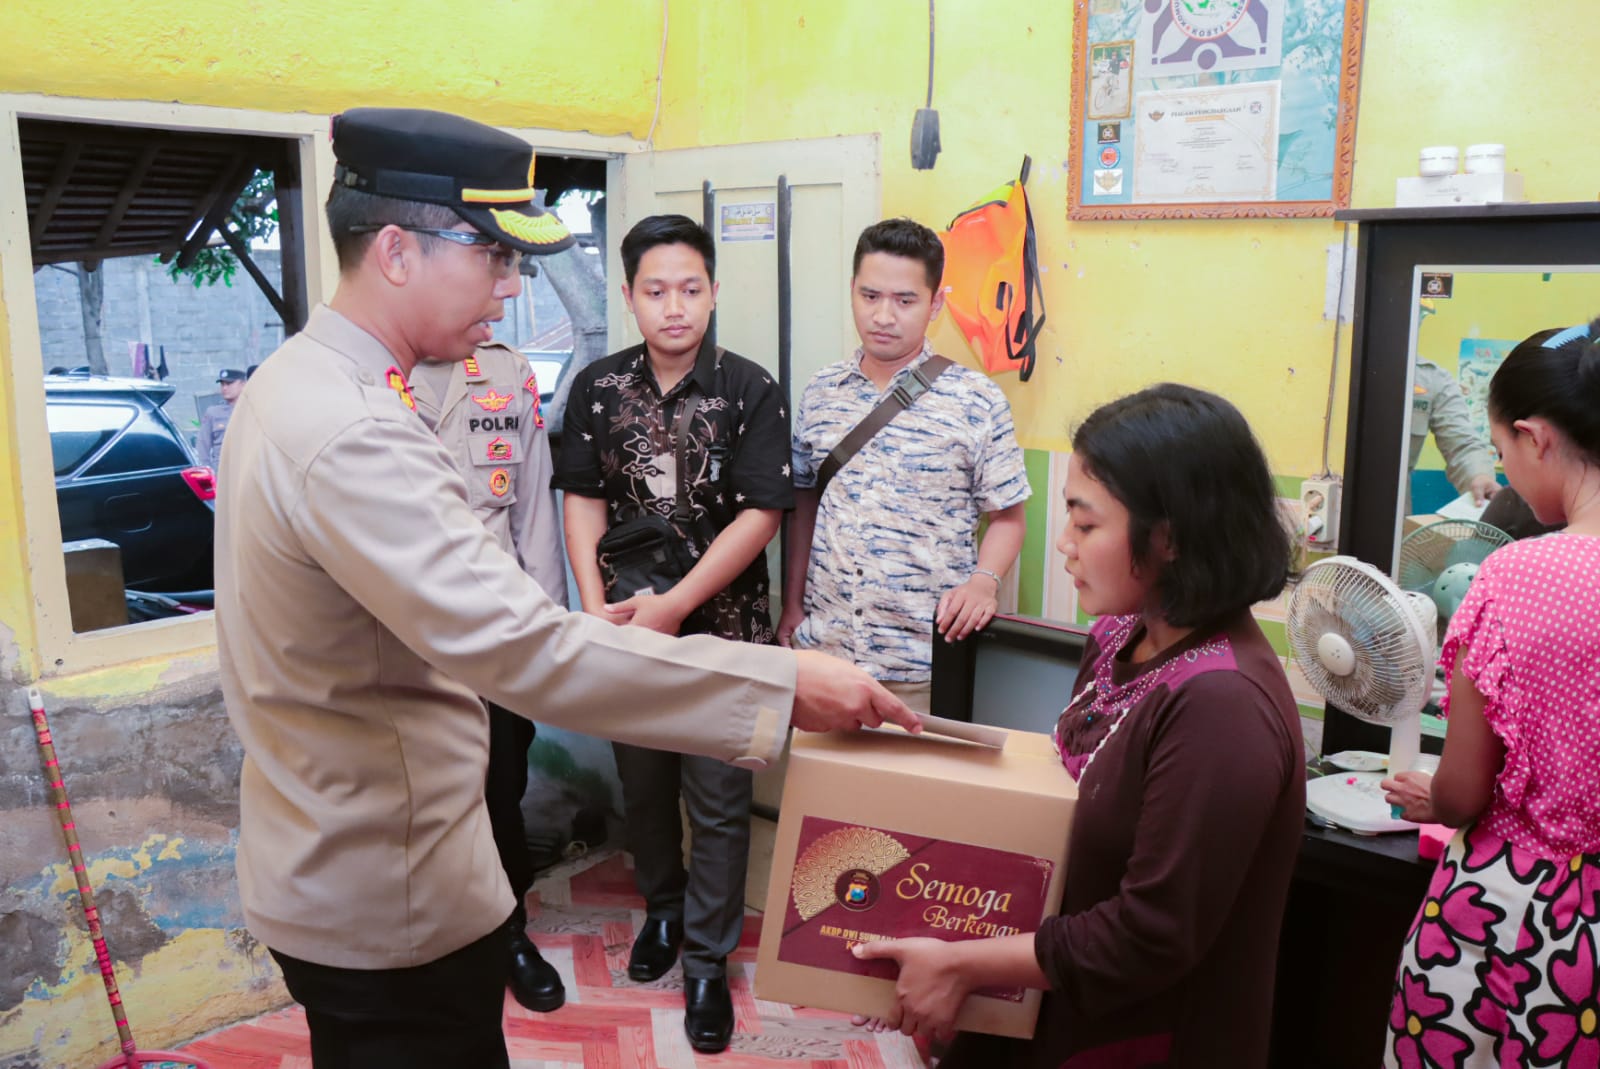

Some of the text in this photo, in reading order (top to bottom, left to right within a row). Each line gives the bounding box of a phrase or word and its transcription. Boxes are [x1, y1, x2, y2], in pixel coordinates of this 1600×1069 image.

[1191, 25, 1224, 37] KOSTI
[469, 416, 519, 432] POLRI
[896, 863, 1012, 920] Semoga
[922, 905, 1020, 938] Berkenan
[843, 928, 858, 940] DWI
